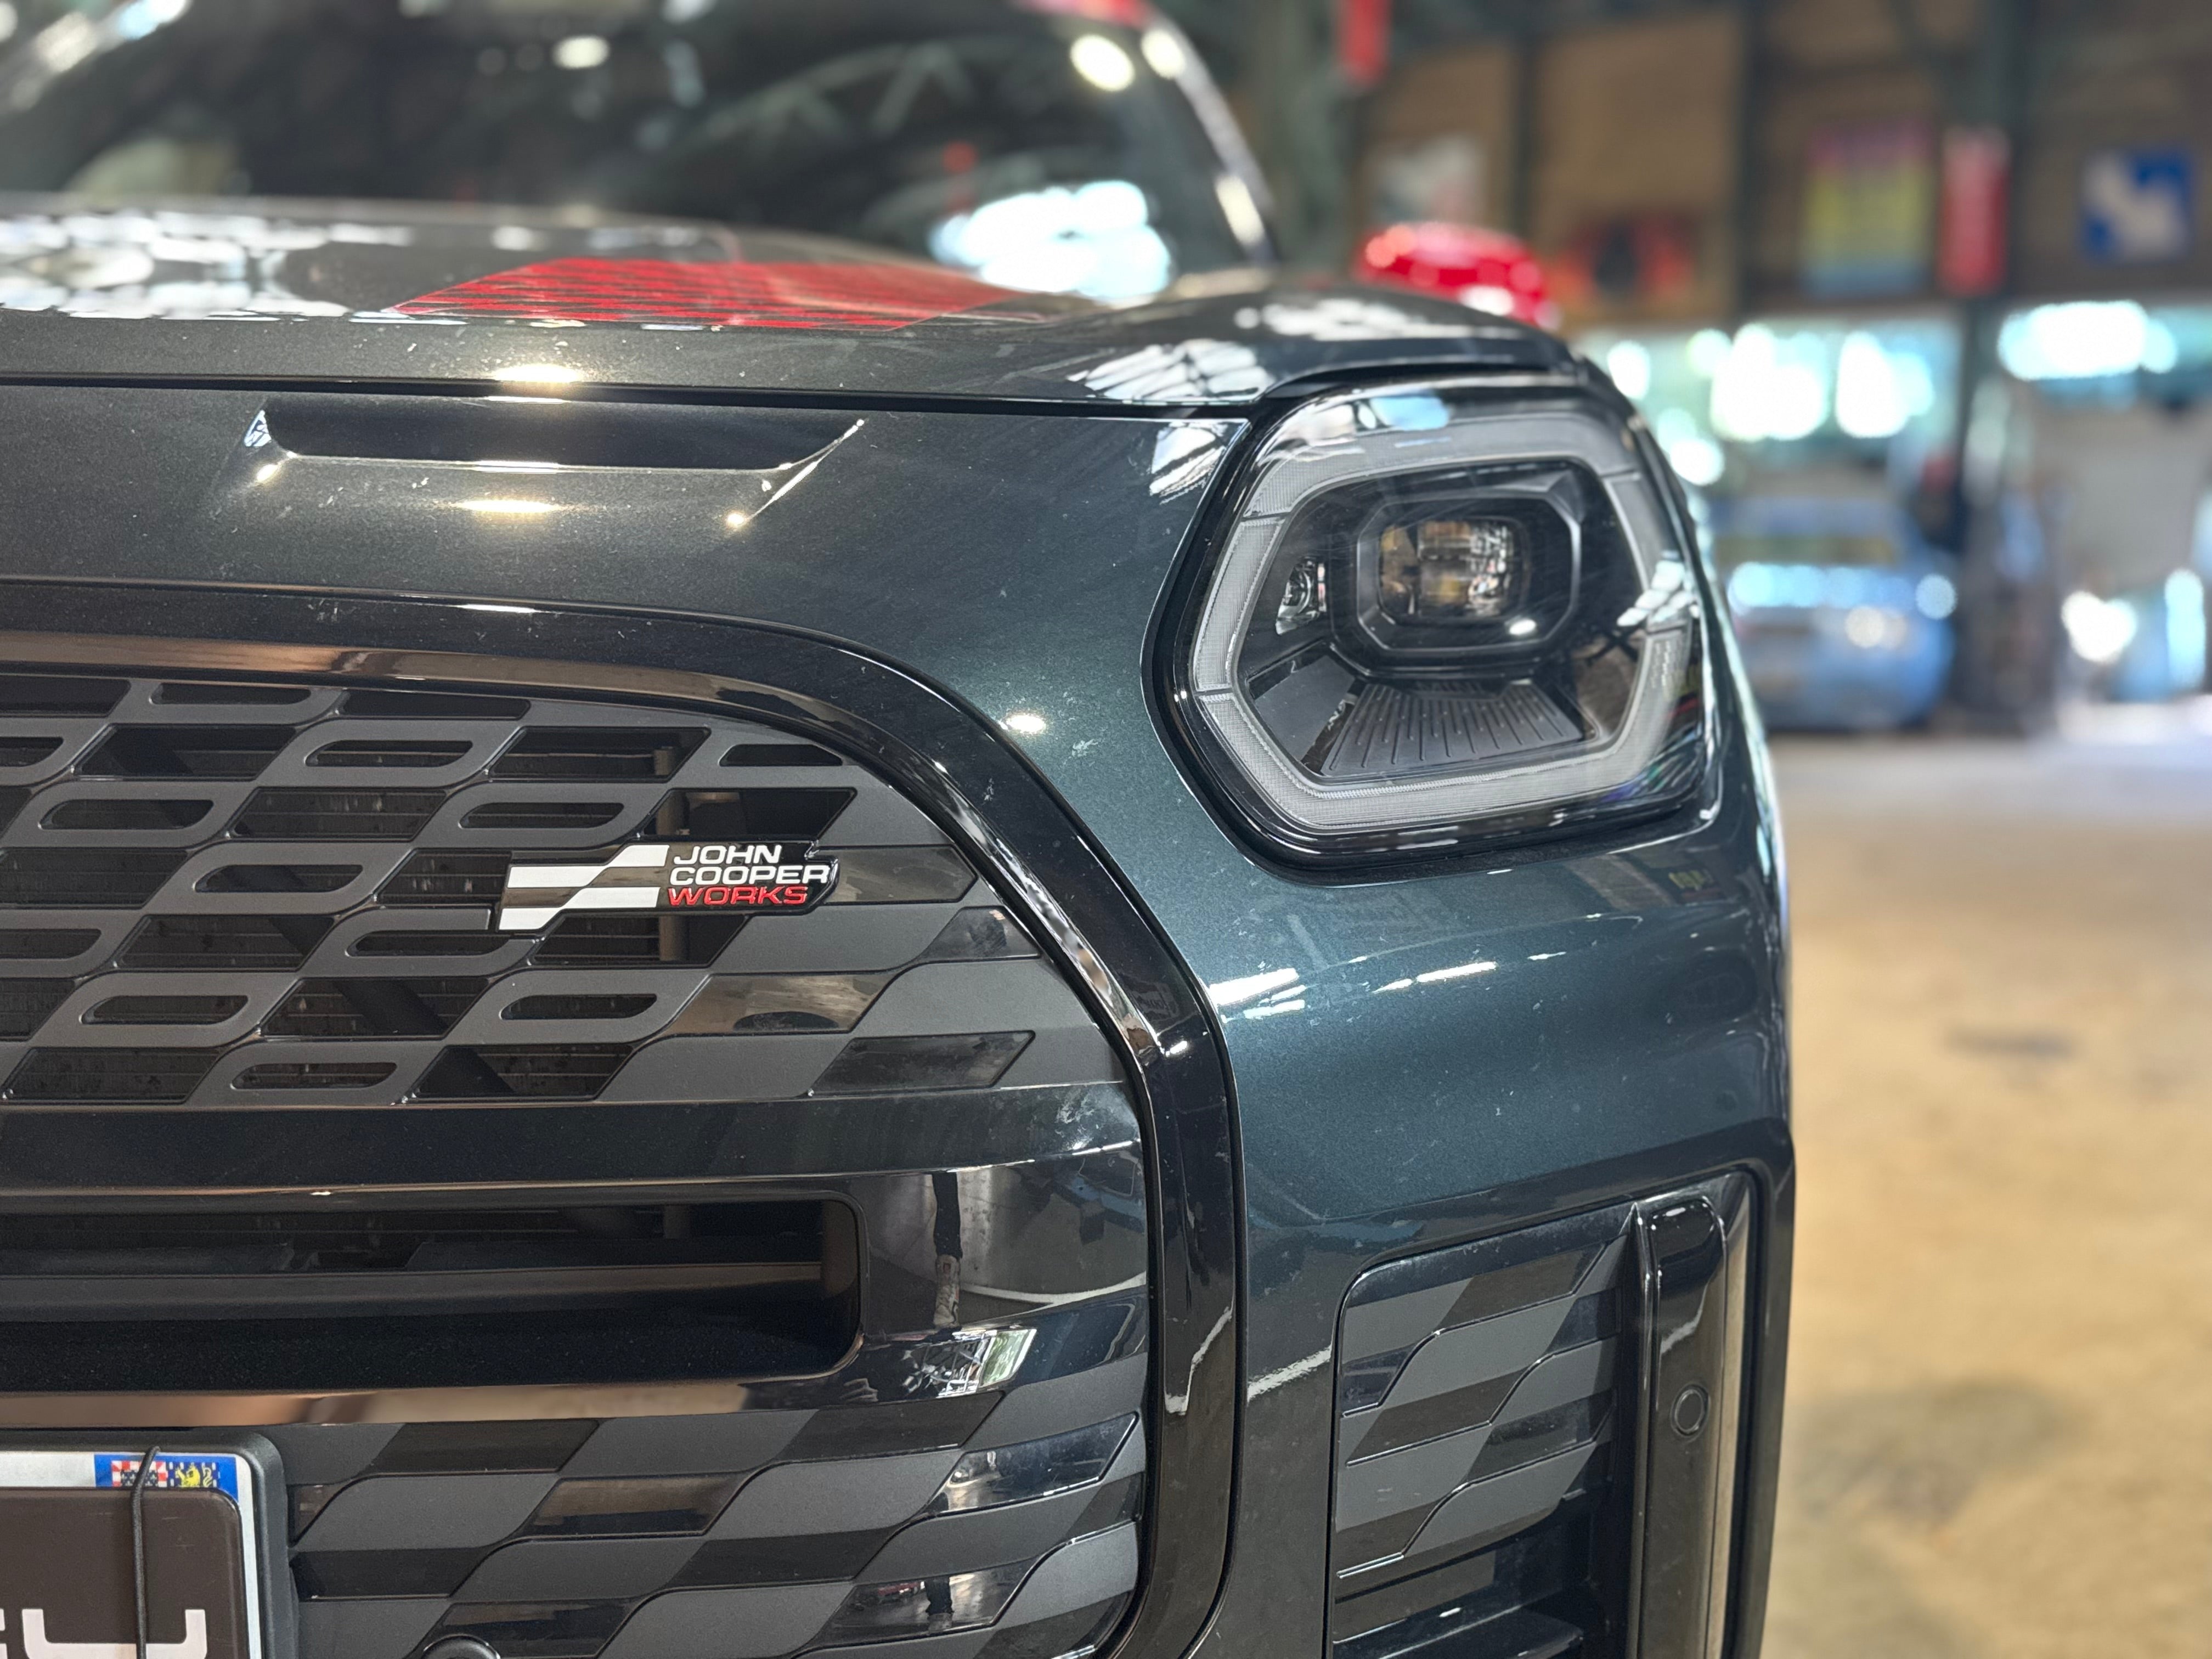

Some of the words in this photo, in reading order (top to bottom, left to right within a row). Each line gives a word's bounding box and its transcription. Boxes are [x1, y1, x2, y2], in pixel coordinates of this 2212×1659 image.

[674, 845, 782, 865] JOHN
[669, 865, 831, 885] COOPER
[668, 885, 808, 906] WORKS
